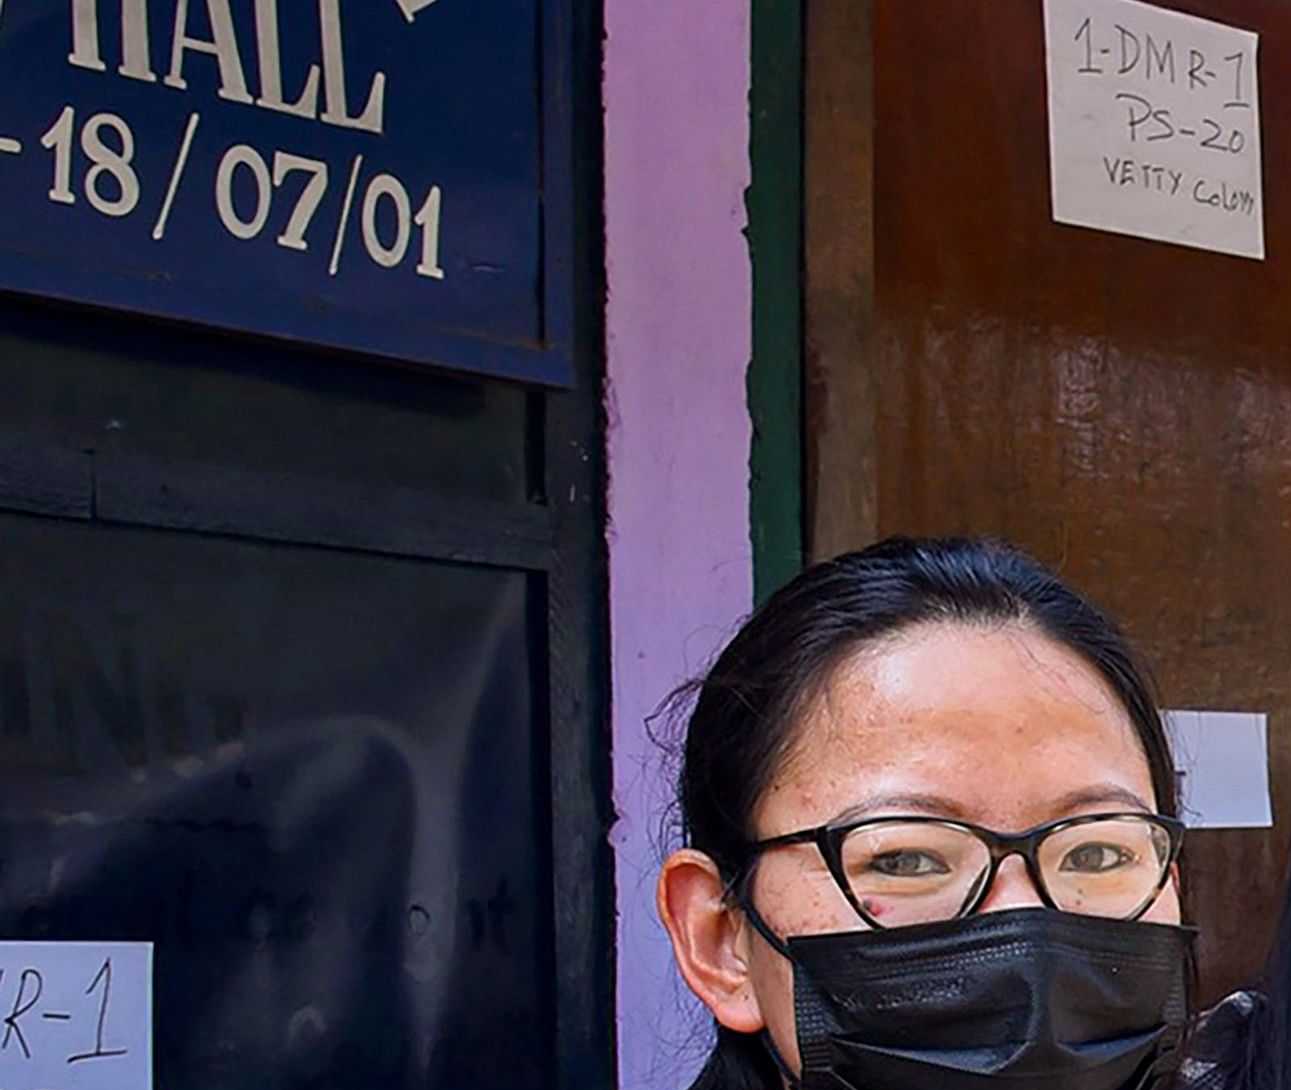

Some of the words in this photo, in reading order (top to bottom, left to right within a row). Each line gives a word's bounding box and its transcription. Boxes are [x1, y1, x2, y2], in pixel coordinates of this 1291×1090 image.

[1115, 92, 1245, 154] PS-20
[1103, 156, 1183, 196] VETTY
[0, 957, 128, 1064] R-1
